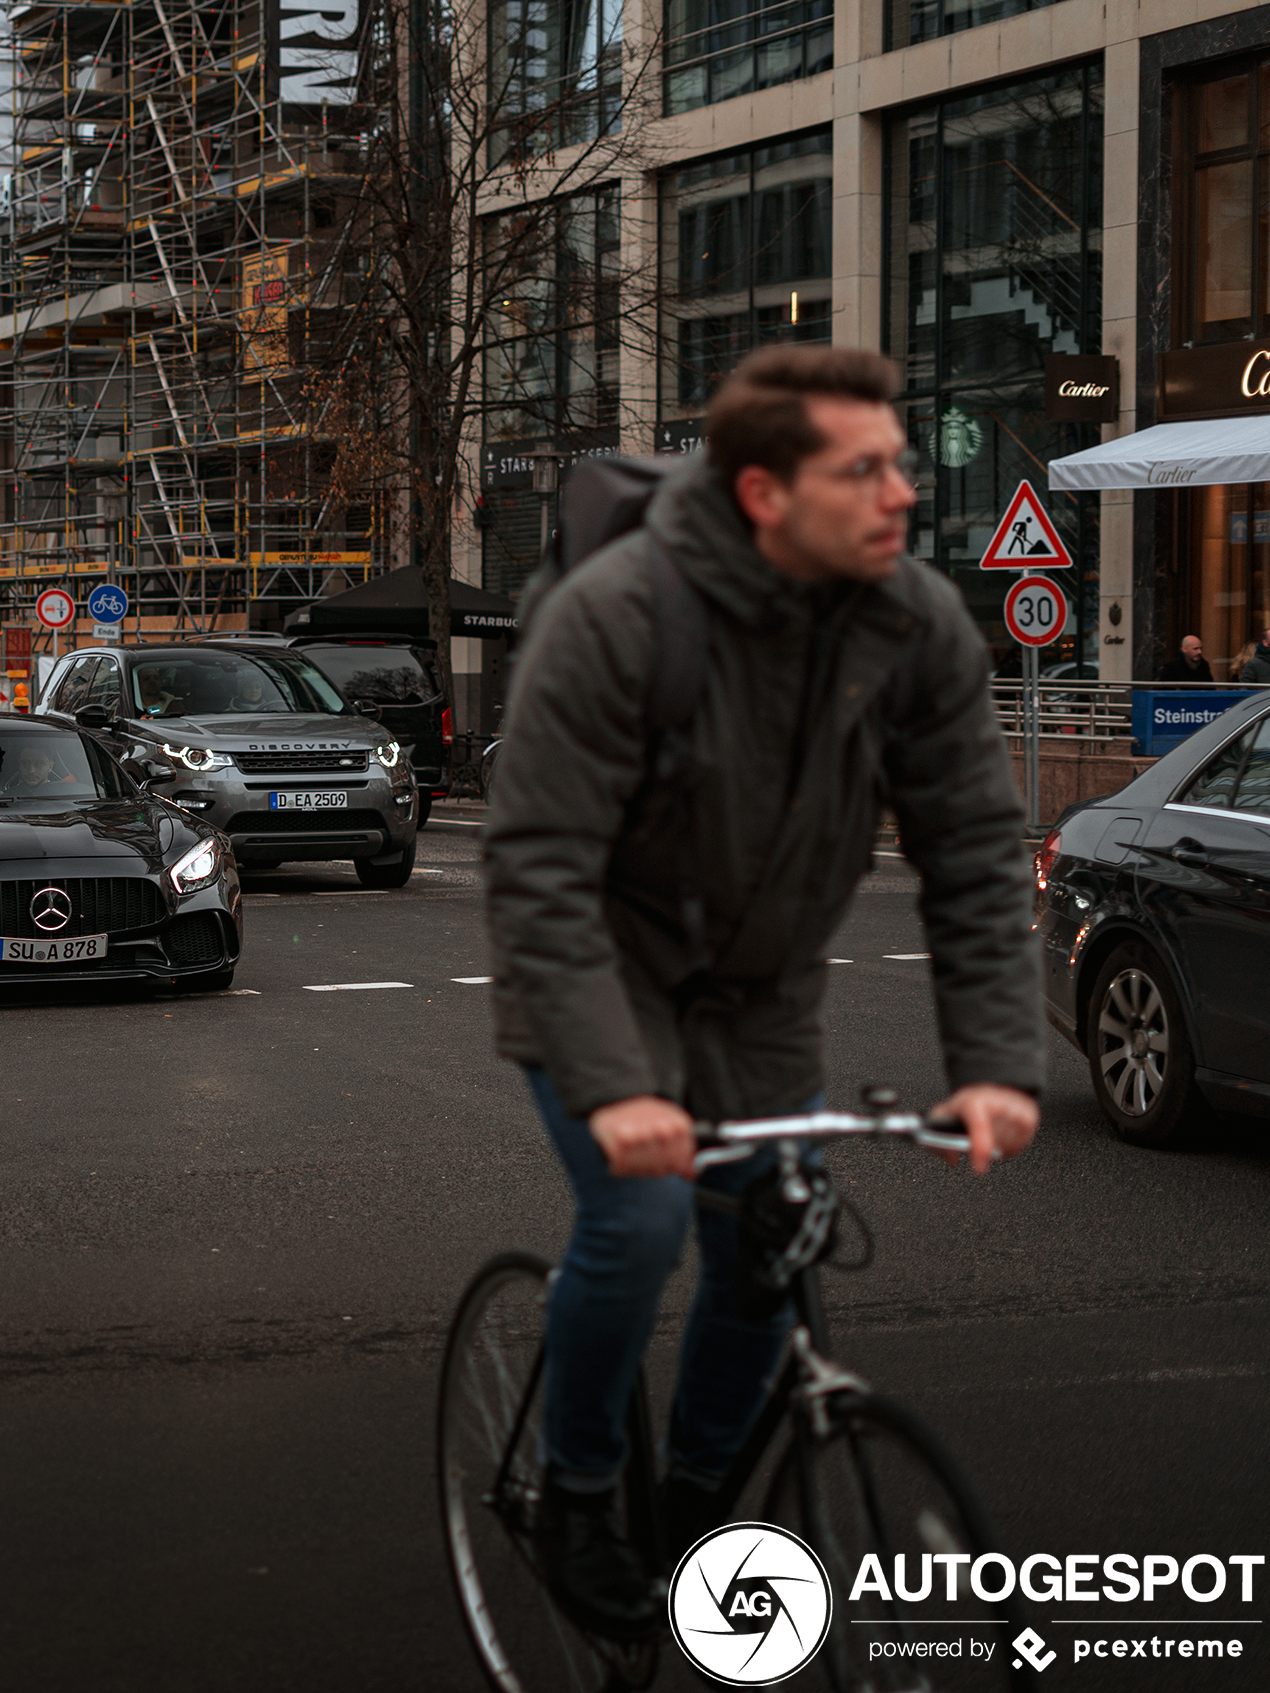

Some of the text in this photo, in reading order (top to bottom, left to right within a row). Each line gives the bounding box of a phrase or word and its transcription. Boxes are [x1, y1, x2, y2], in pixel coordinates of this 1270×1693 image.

[1058, 379, 1110, 397] Cartier
[1147, 461, 1197, 485] Cartier
[1018, 596, 1053, 627] 30
[278, 793, 346, 807] D EA 2509
[8, 942, 34, 960] SU
[47, 944, 58, 960] A
[63, 939, 97, 959] 878
